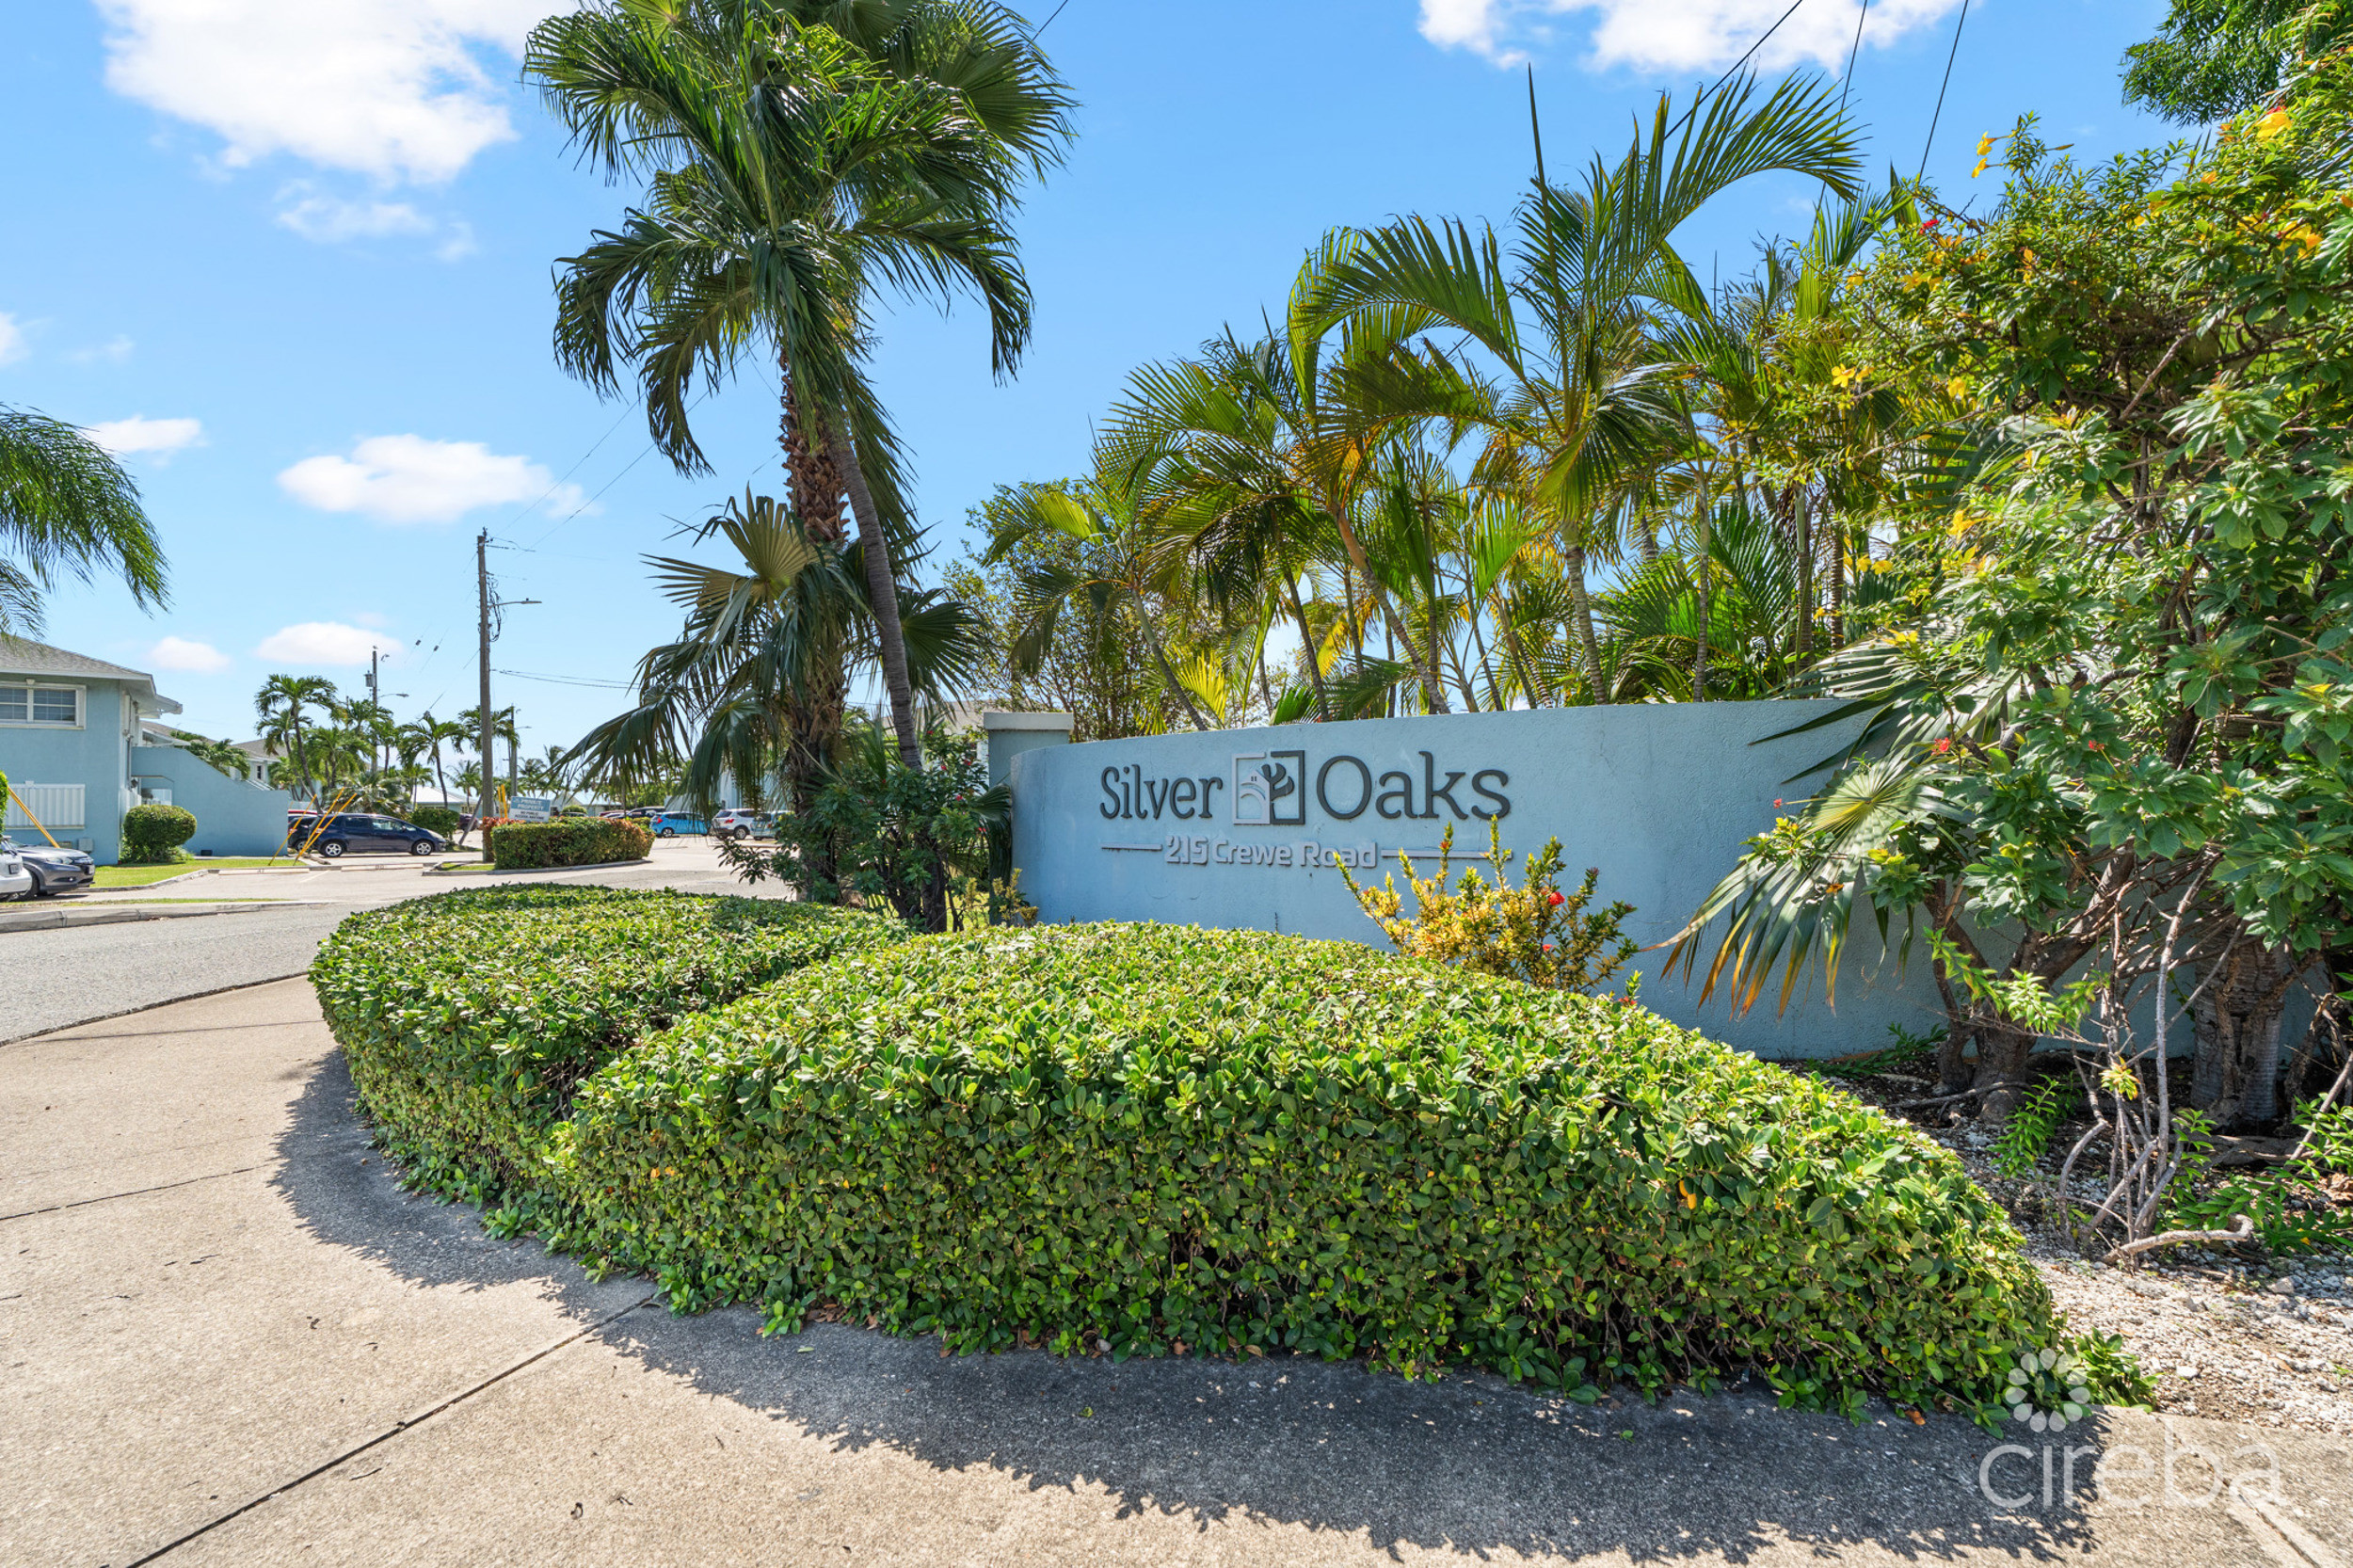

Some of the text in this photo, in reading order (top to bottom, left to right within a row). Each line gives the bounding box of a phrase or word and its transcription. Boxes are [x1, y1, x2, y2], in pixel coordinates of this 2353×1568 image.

[1099, 750, 1512, 821] Silver Oaks
[1164, 835, 1378, 869] 215 Crewe Road
